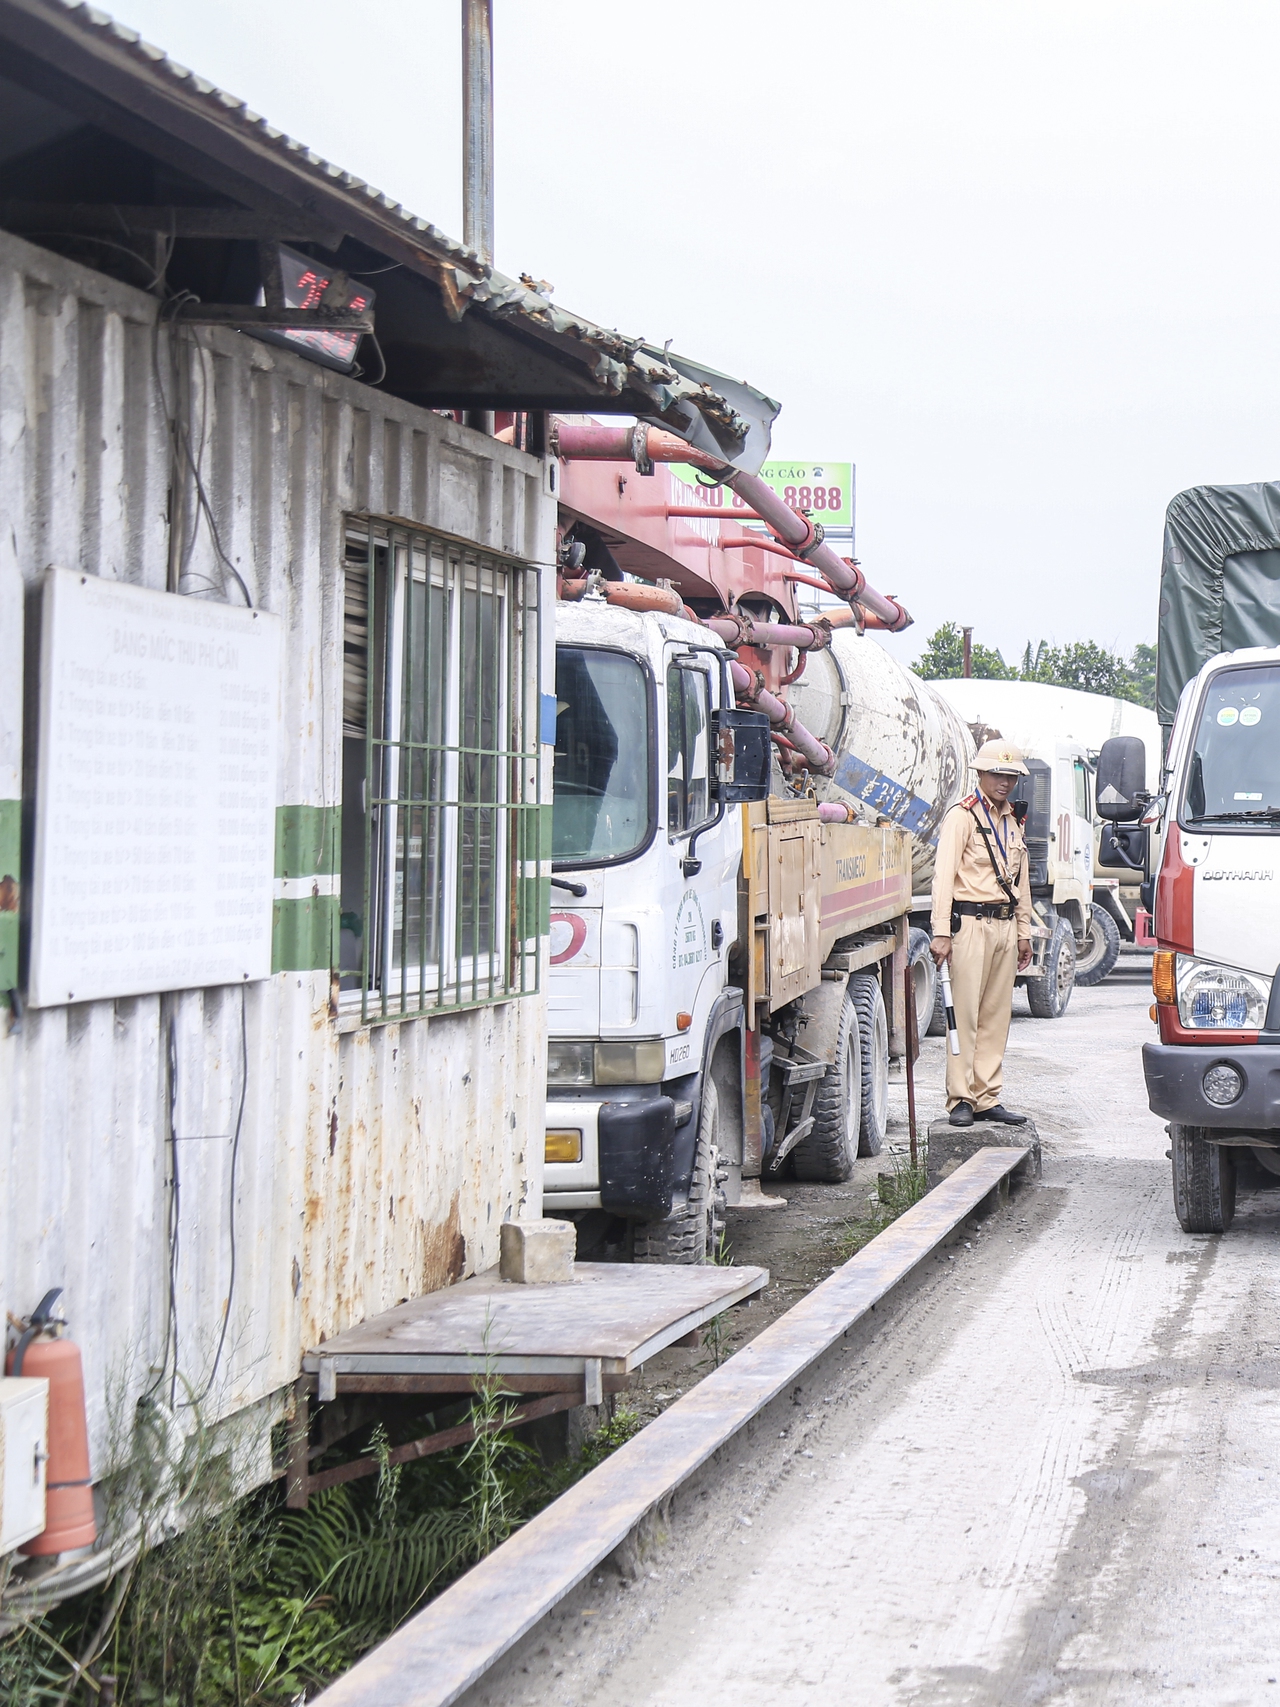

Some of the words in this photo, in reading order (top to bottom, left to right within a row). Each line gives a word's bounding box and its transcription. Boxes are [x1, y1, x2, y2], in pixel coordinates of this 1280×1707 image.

[778, 466, 805, 478] CÁO
[784, 486, 842, 510] 8888
[113, 620, 147, 658] BẢNG
[178, 638, 196, 665] THU
[1057, 813, 1070, 862] 10
[836, 855, 866, 882] TRANSMECO
[670, 1044, 690, 1064] HD260
